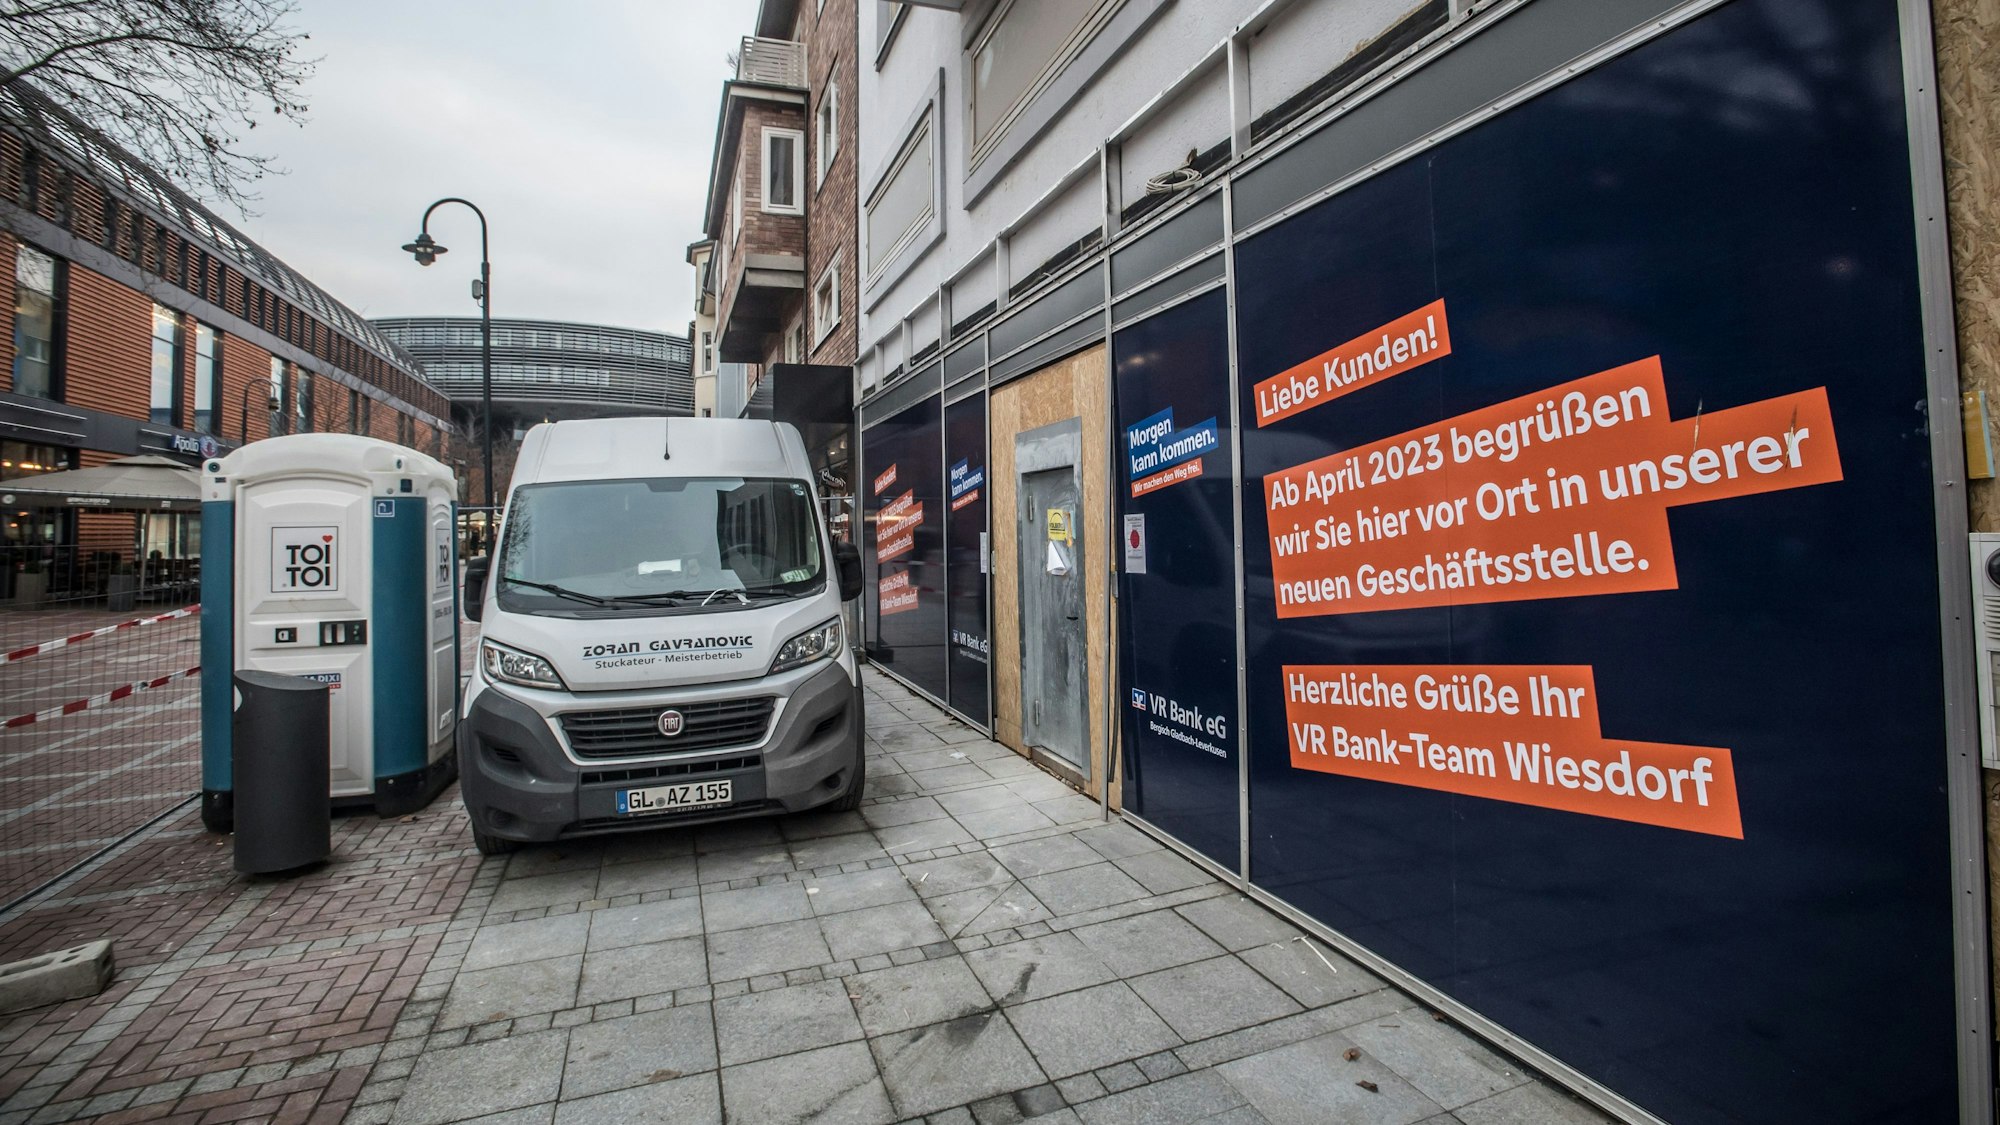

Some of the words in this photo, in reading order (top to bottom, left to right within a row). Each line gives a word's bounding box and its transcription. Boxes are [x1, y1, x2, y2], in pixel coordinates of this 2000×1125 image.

[1260, 375, 1319, 418] Liebe
[1323, 315, 1438, 392] Kunden!
[174, 435, 199, 453] Apollo
[1130, 418, 1172, 449] Morgen
[1271, 479, 1300, 511] Ab
[1304, 456, 1365, 505] April
[1368, 433, 1444, 486] 2023
[1450, 385, 1651, 463] begrüßen
[1131, 451, 1158, 474] kann
[1159, 429, 1215, 463] kommen.
[1134, 483, 1143, 493] Wir
[1143, 477, 1163, 490] machen
[1163, 473, 1174, 483] den
[1174, 468, 1187, 479] Weg
[1187, 462, 1200, 474] frei.
[1274, 524, 1310, 557] wir
[1314, 516, 1351, 551] Sie
[1356, 506, 1410, 542] hier
[1416, 496, 1468, 532] vor
[1476, 477, 1541, 521] Ort
[1546, 468, 1588, 510] in
[1599, 427, 1809, 501] unserer
[286, 544, 330, 565] TOI
[1280, 575, 1351, 605] neuen
[1356, 531, 1649, 598] Geschäftsstelle.
[286, 566, 330, 587] TOI
[583, 642, 640, 657] ZORAN
[967, 634, 980, 651] Bank
[595, 657, 656, 669] Stuckateur
[665, 651, 743, 663] Meisterbetrieb
[318, 674, 340, 682] DIXI
[1289, 672, 1407, 709] Herzliche
[1415, 673, 1520, 715] Grüße
[1528, 675, 1585, 718] Ihr
[664, 717, 679, 730] FIAT
[1149, 693, 1167, 719] VR
[1170, 700, 1203, 731] Bank
[1206, 715, 1226, 739] eG
[1150, 721, 1170, 736] Bergisch
[1170, 729, 1227, 758] Gladbach-Leverkusen
[1292, 722, 1328, 755] VR
[1332, 725, 1496, 778] Bank-Team
[1503, 741, 1713, 806] Wiesdorf
[629, 791, 653, 809] GL
[667, 786, 691, 806] AZ
[695, 782, 729, 802] 155
